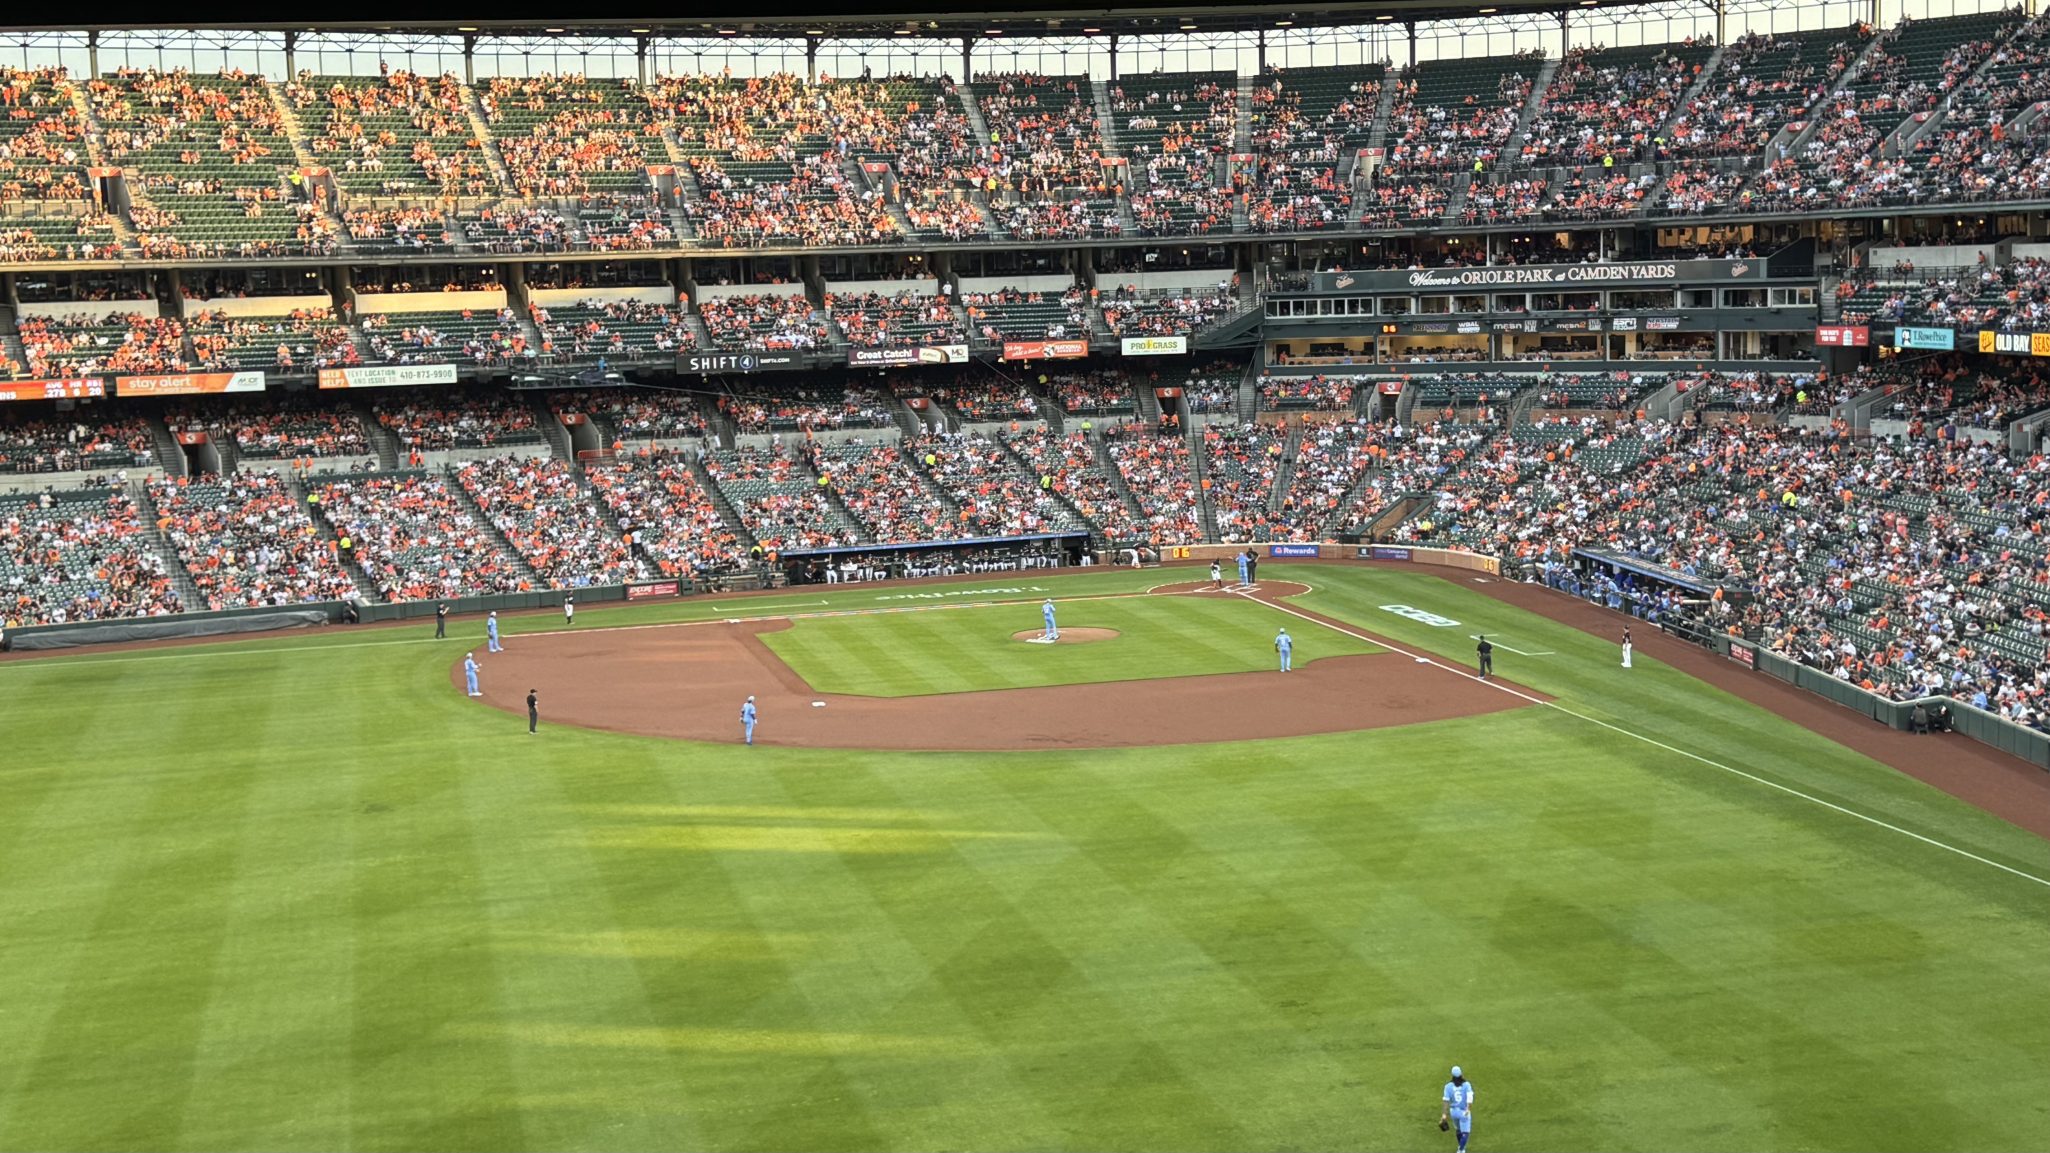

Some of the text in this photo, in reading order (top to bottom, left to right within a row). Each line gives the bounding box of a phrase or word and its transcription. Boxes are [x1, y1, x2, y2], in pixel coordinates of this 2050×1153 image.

[1409, 270, 1450, 286] Welcome
[1450, 276, 1461, 285] to
[1461, 270, 1515, 284] ORIOLE
[1516, 268, 1553, 282] PARK
[1567, 266, 1629, 280] CAMDEN
[1630, 264, 1676, 279] YARDS
[1152, 341, 1178, 349] GRASS
[1996, 333, 2030, 352] OLD BAY
[856, 351, 883, 360] Great
[883, 349, 913, 359] Catch!
[690, 356, 738, 370] SHIFT
[364, 369, 397, 377] LOCATION
[129, 378, 156, 390] stay
[159, 377, 192, 388] alert
[367, 376, 386, 384] ISSUE
[88, 387, 101, 396] 20
[1283, 547, 1316, 555] Rewards
